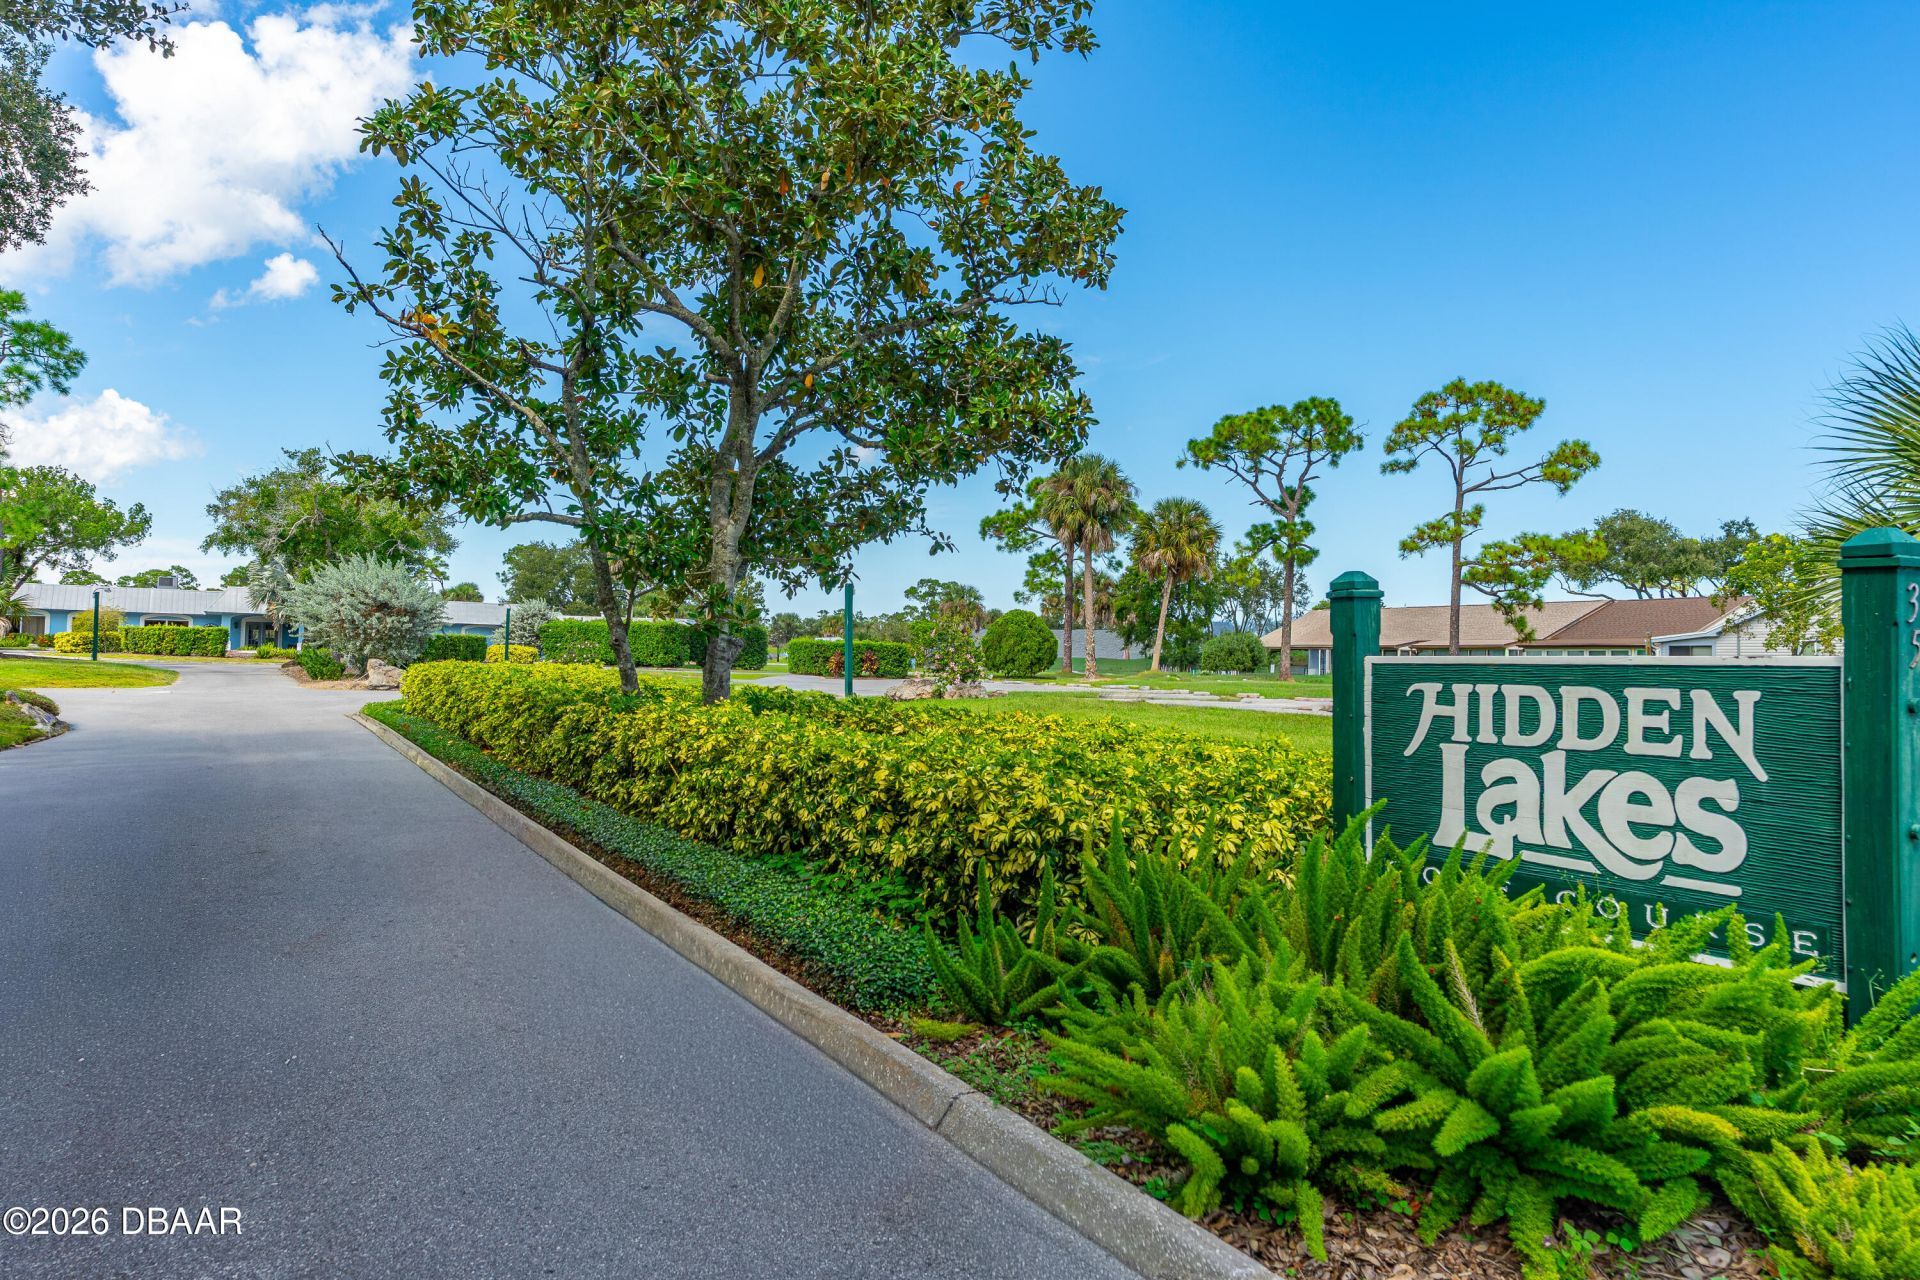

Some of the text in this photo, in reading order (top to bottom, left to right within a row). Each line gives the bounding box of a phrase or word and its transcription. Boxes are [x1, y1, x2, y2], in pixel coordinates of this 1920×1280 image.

[1404, 682, 1769, 782] HIDDEN
[1432, 743, 1748, 881] Lakes
[1555, 889, 1819, 957] COUSE
